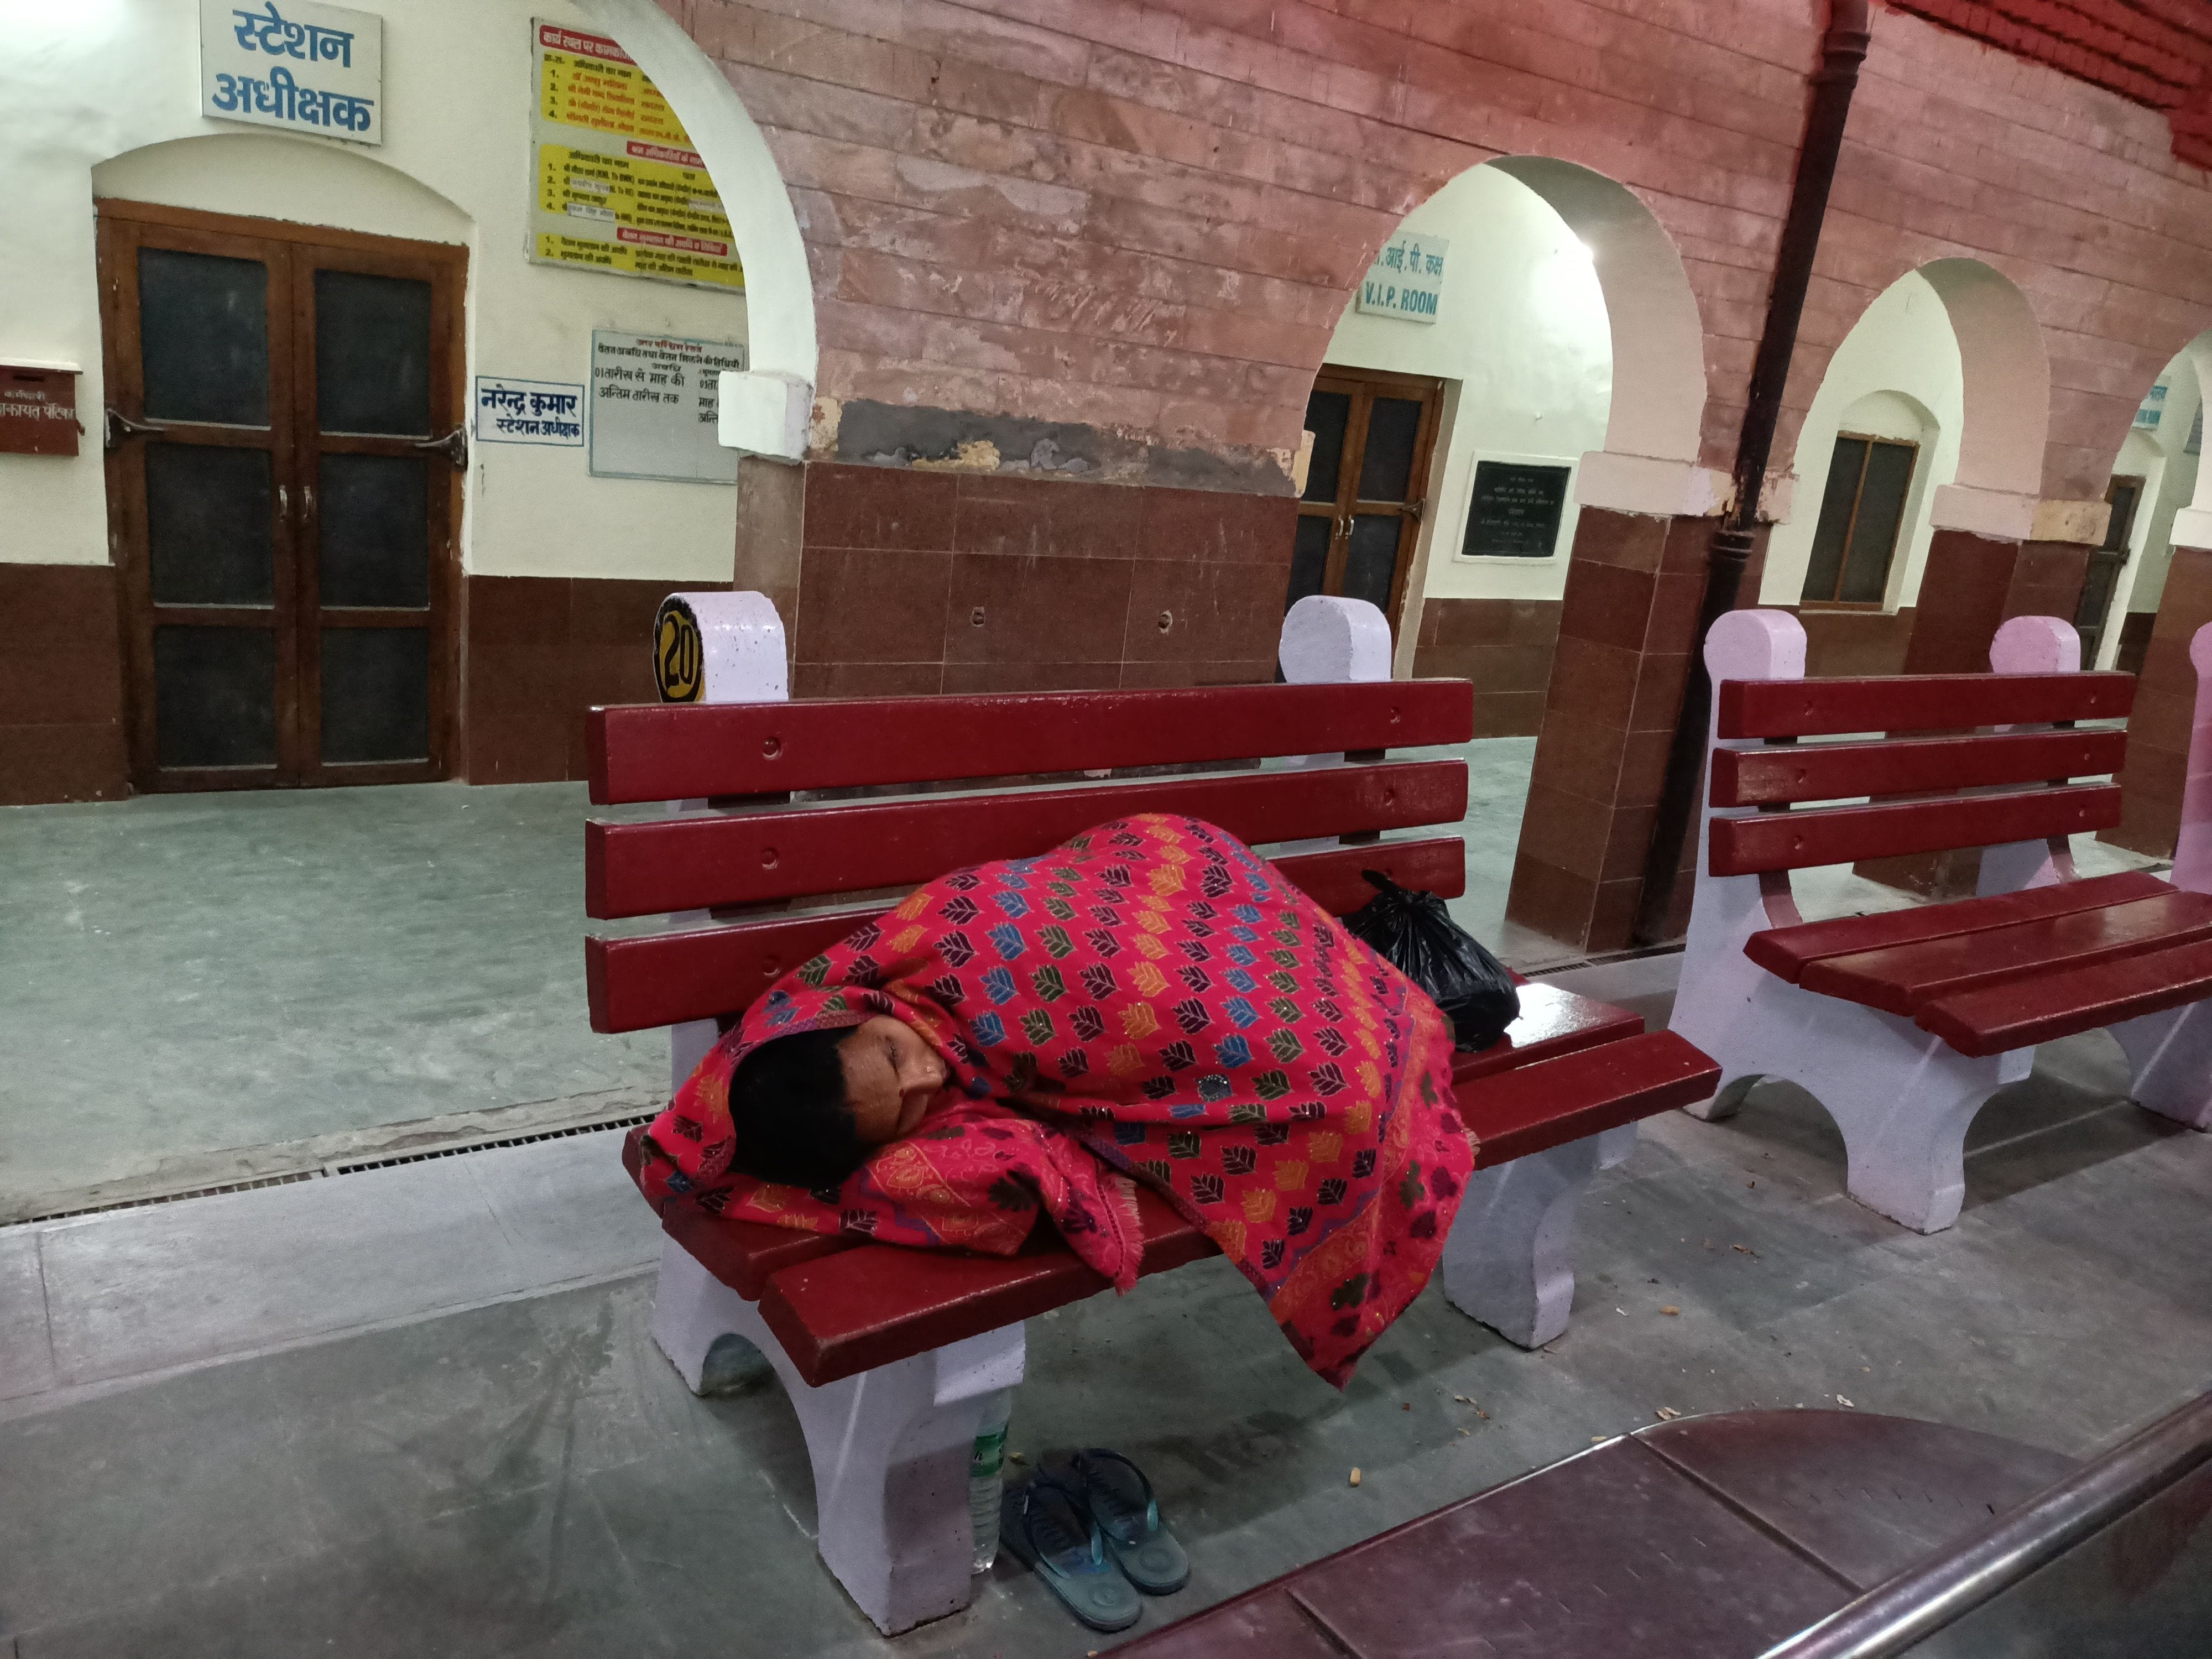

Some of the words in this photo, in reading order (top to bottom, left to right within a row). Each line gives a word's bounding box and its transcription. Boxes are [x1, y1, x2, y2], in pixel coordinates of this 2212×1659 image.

[233, 1, 354, 69] स्टेशन
[212, 66, 374, 132] अधीक्षक
[1426, 254, 1444, 276] कक्ष
[1366, 281, 1396, 309] V.I.P.
[1400, 288, 1438, 315] ROOM
[635, 368, 646, 382] से
[670, 373, 685, 387] की
[481, 383, 527, 416] नरेन्द्र
[530, 392, 578, 418] कुमार
[662, 393, 680, 404] तक
[496, 413, 540, 437] स्टेशन
[665, 613, 693, 691] 20
